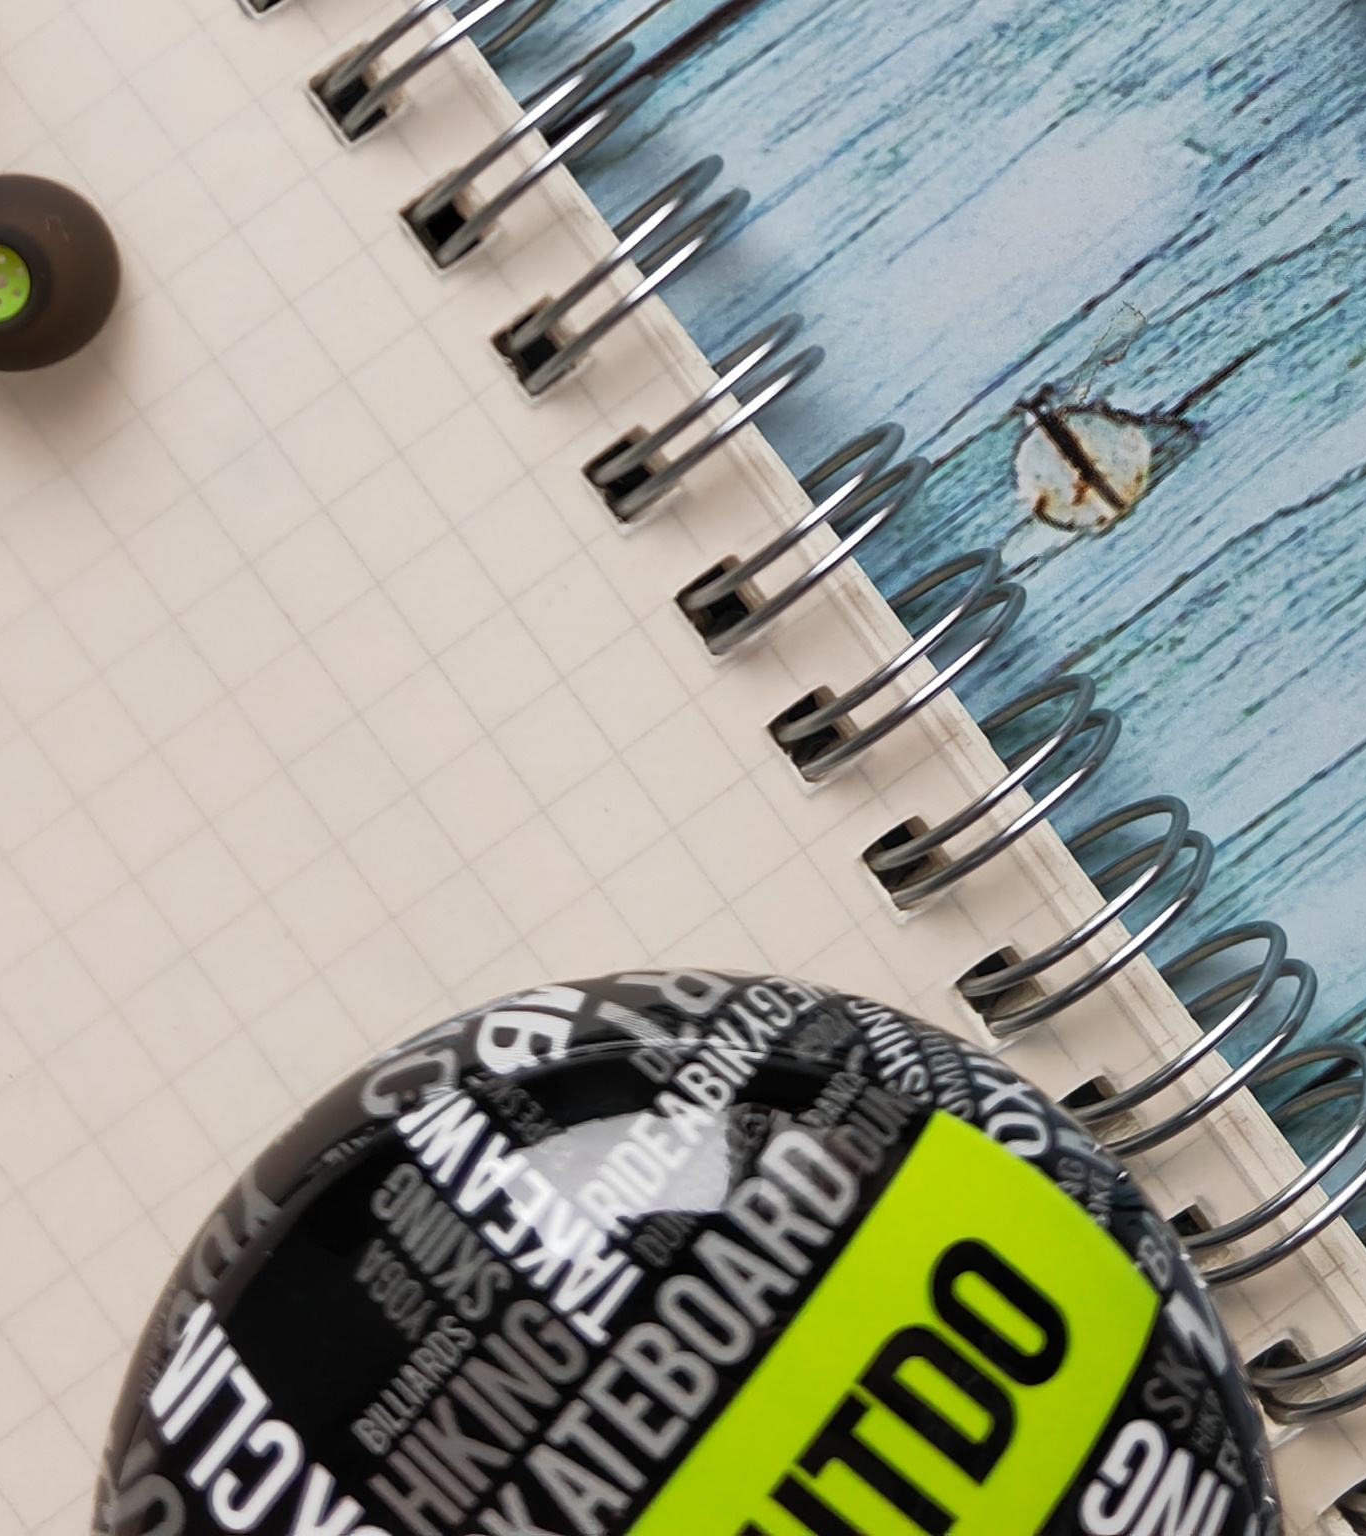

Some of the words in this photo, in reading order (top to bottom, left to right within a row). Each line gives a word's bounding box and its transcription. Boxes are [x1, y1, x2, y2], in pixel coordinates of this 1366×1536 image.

[353, 1237, 437, 1342] YOGA
[370, 1163, 514, 1321] SKIING
[473, 1129, 861, 1536] KATEBOARD
[349, 1314, 477, 1456] BILLIARDS
[366, 1298, 590, 1536] HIKING
[735, 1238, 1071, 1536] TDO
